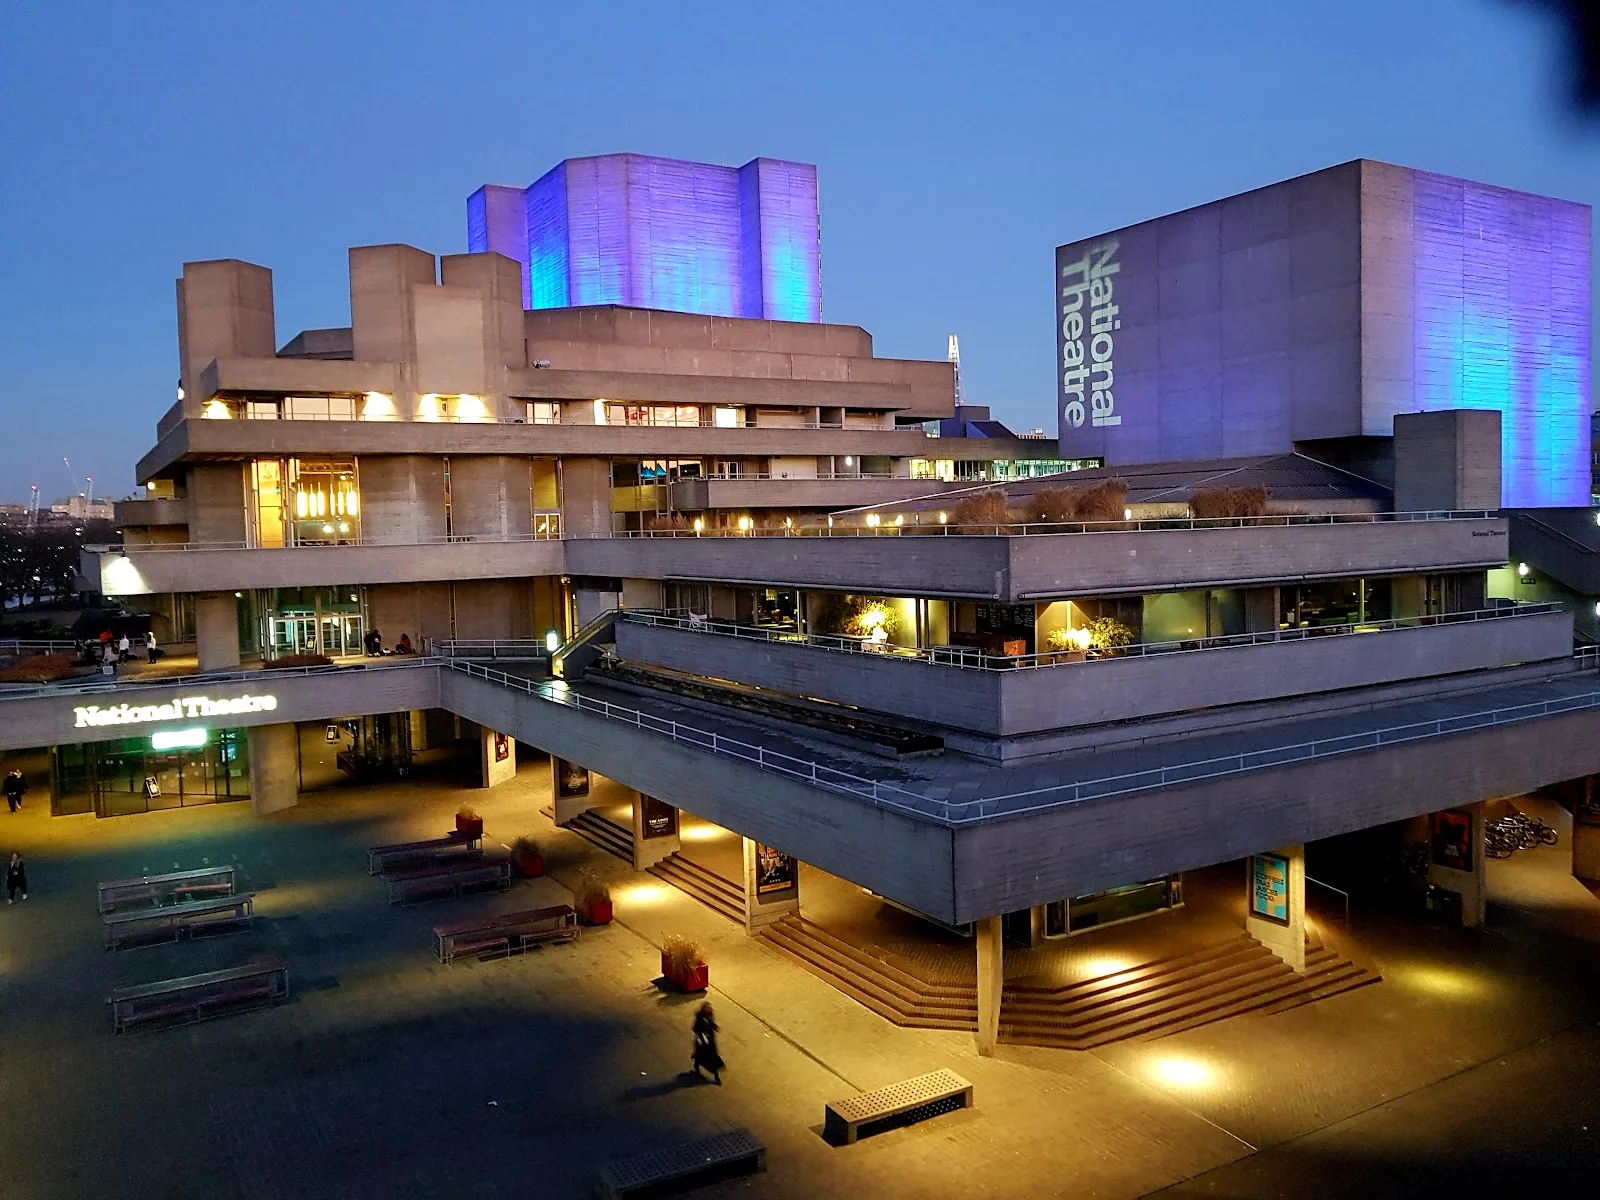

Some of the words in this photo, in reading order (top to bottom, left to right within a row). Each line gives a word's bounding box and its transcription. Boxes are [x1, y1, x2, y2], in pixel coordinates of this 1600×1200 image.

[1062, 251, 1091, 428] Theatre
[1089, 239, 1122, 428] National
[73, 698, 183, 728] National
[183, 694, 278, 717] Theatre
